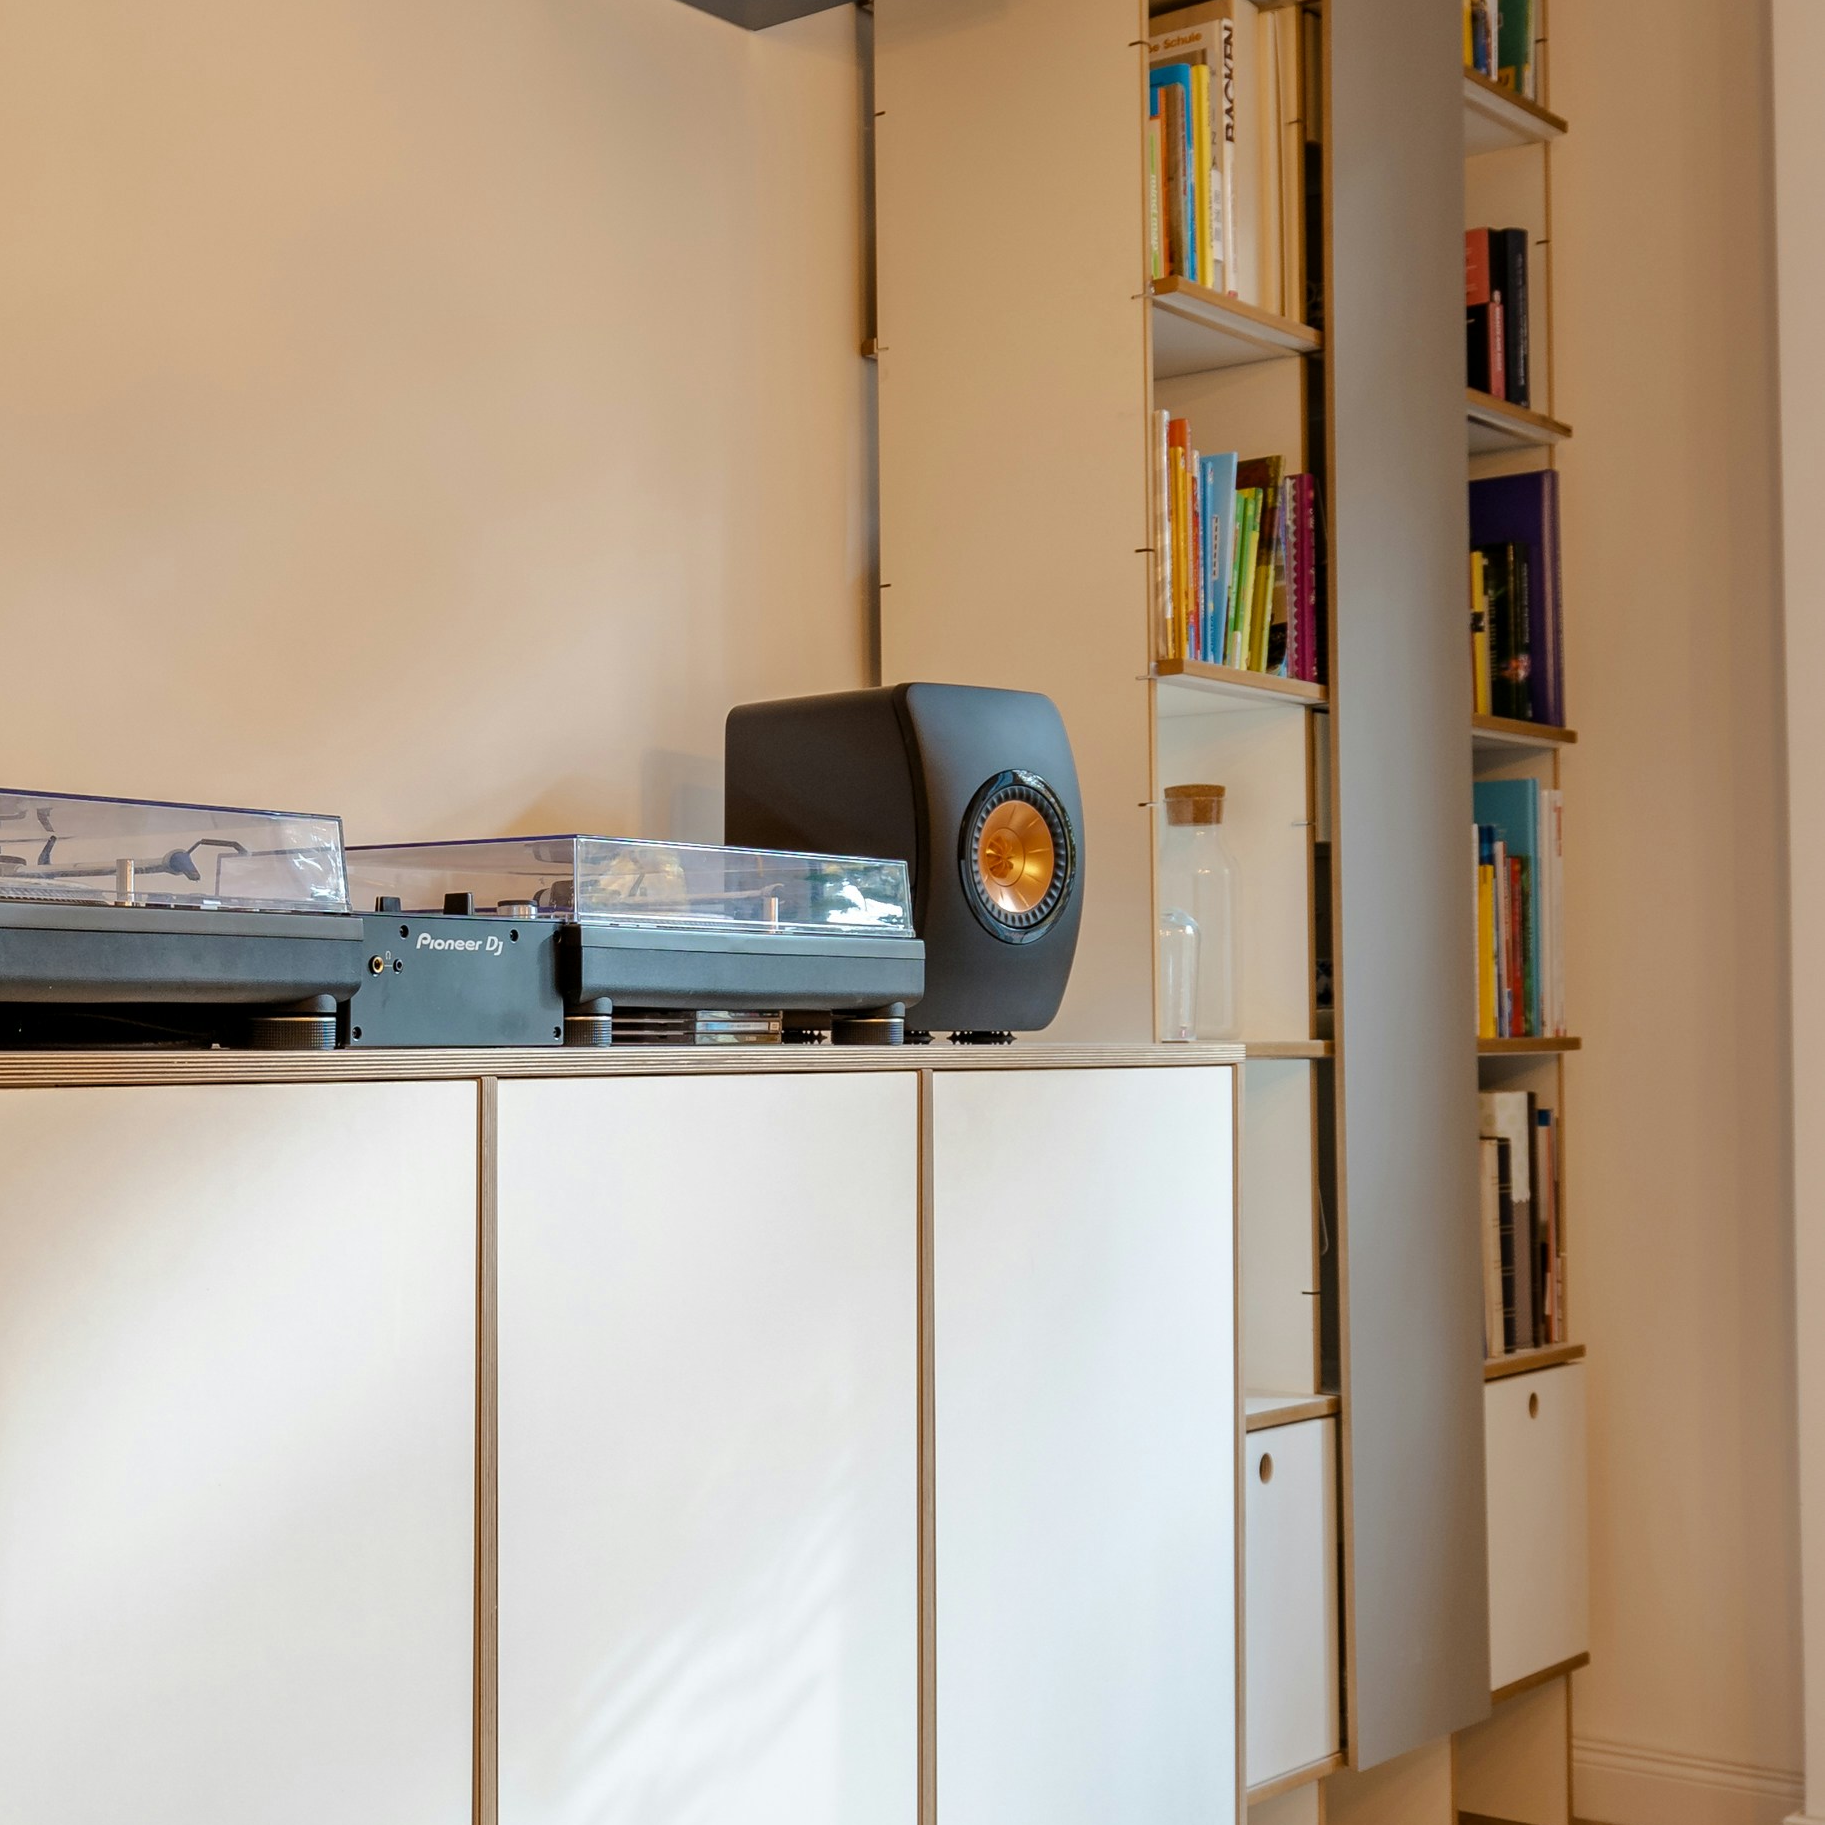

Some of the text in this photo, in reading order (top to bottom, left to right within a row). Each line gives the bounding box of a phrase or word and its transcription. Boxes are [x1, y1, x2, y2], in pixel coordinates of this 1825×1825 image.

[1163, 32, 1202, 49] Schule
[416, 932, 503, 956] Pioneer DJ
